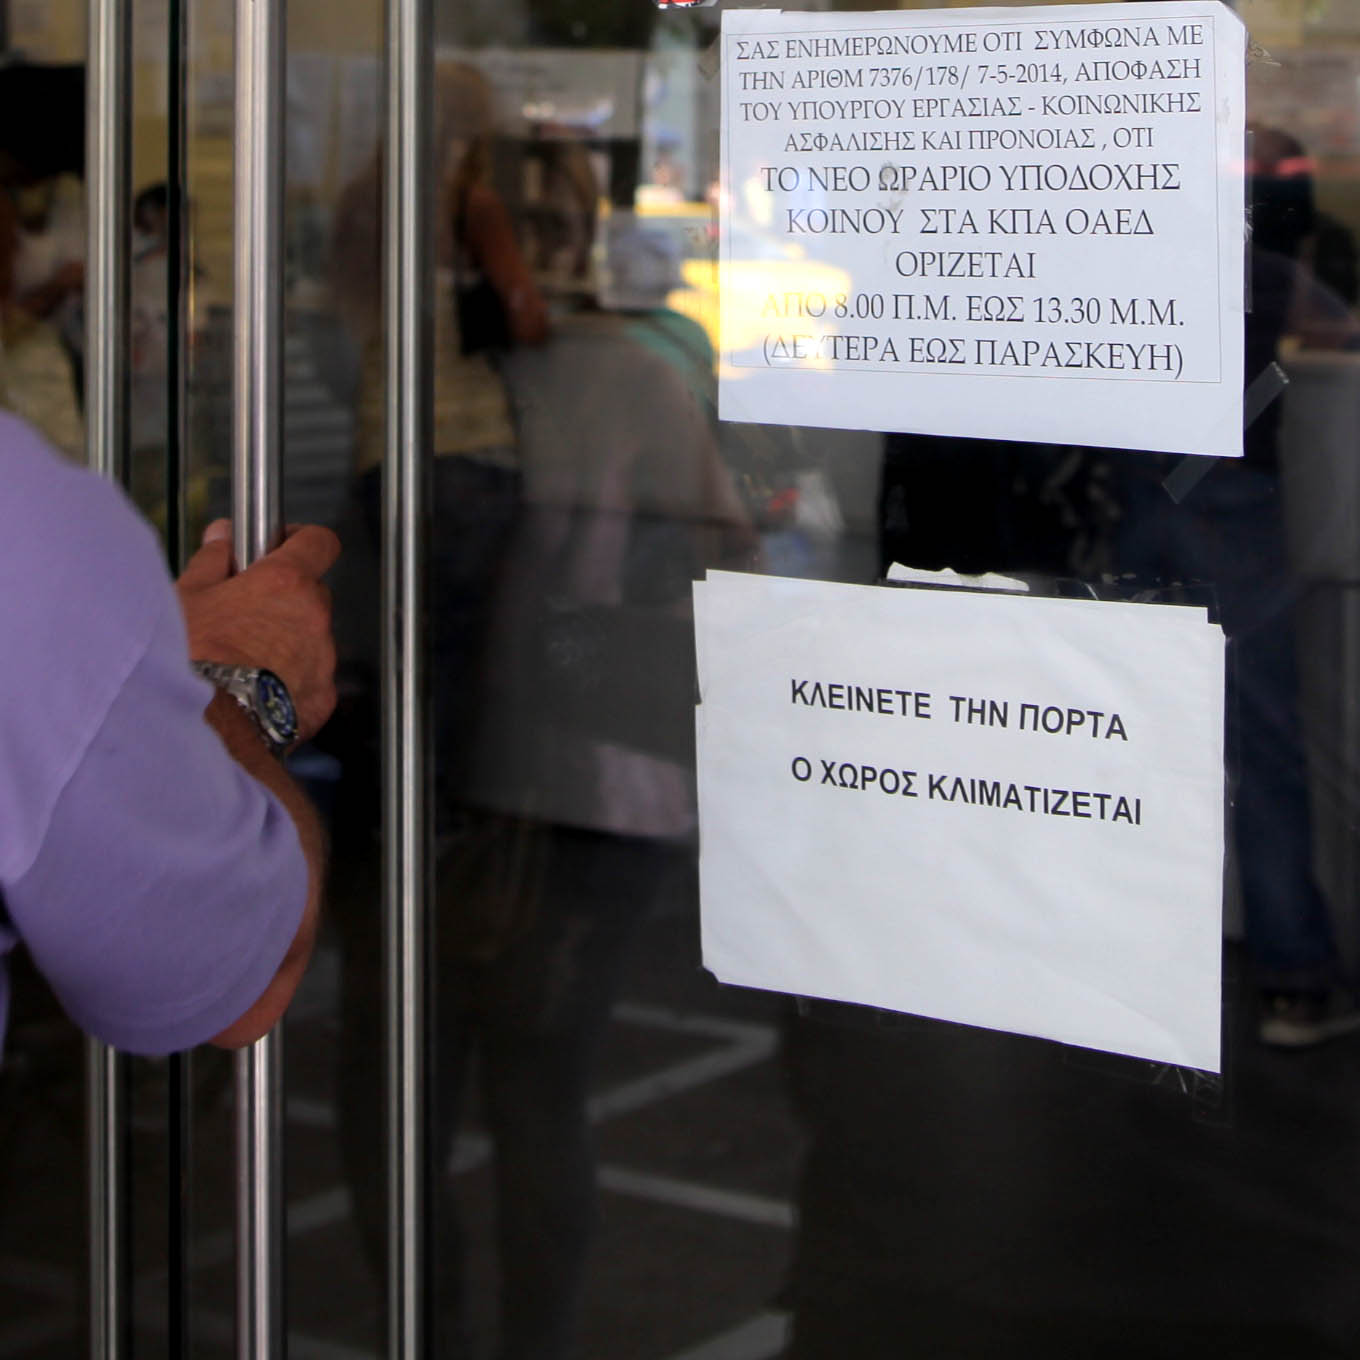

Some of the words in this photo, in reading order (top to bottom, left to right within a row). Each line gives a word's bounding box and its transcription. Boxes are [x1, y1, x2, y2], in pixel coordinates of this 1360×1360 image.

[735, 40, 780, 61] ΣΑΣ
[785, 34, 978, 59] ΕΝΗΜΕΡΩΝΟΥΜΕ
[983, 31, 1022, 53] ΟΤΙ
[1034, 26, 1160, 51] ΣΥΜΦΩΝΑ
[1167, 24, 1204, 47] ΜΕ
[740, 69, 785, 91] ΤΗΝ
[791, 68, 864, 90] ΑΡΙΘΜ
[978, 62, 1069, 87] 7-5-2014,
[1074, 58, 1201, 82] ΑΠΟΦΑΣΗ
[740, 101, 783, 122] ΤΟΥ
[788, 99, 907, 121] ΥΠΟΥΡΓΟΥ
[913, 96, 1021, 119] ΕΡΓΑΣΙΑΣ
[1041, 93, 1201, 116] ΚΟΙΝΩΝΙΚΗΣ
[784, 130, 915, 153] ΑΣΦΑΛΙΣΗΣ
[921, 129, 963, 151] ΚΑΙ
[1113, 127, 1154, 148] ΟΤΙ
[761, 167, 800, 192] ΤΟ
[808, 166, 870, 192] ΝΕΟ
[879, 164, 991, 192] ΩΡΑΡΙΟ
[1000, 162, 1181, 191] ΥΠΟΔΟΧΗΣ
[787, 208, 903, 235] ΚΟΙΝΟΥ
[920, 209, 979, 235] ΣΤΑ
[988, 208, 1056, 235] ΚΠΑ
[1064, 208, 1154, 235] ΟΑΕΔ
[895, 252, 1037, 279] ΟΡΙΖΕΤΑΙ
[834, 294, 884, 319] 8.00
[893, 295, 958, 321] Π.Μ.
[966, 297, 1025, 323] ΕΩΣ
[1034, 298, 1101, 325] 13.30
[1110, 299, 1184, 327] Μ.Μ.
[909, 338, 966, 365] ΕΩΣ
[974, 339, 1183, 379] ΠΑΡΑΣΚΕΥΗ)
[791, 679, 932, 718] ΚΛΕΙΝΕΤΕ
[950, 695, 1008, 728] ΤΗΝ
[1019, 703, 1128, 741] ΠΟΡΤΑ
[791, 756, 812, 782] Ο
[821, 760, 917, 797] ΧΩΡΟΣ
[928, 774, 1142, 825] ΚΛΙΜΑΤΙΖΕΤΑΙ
